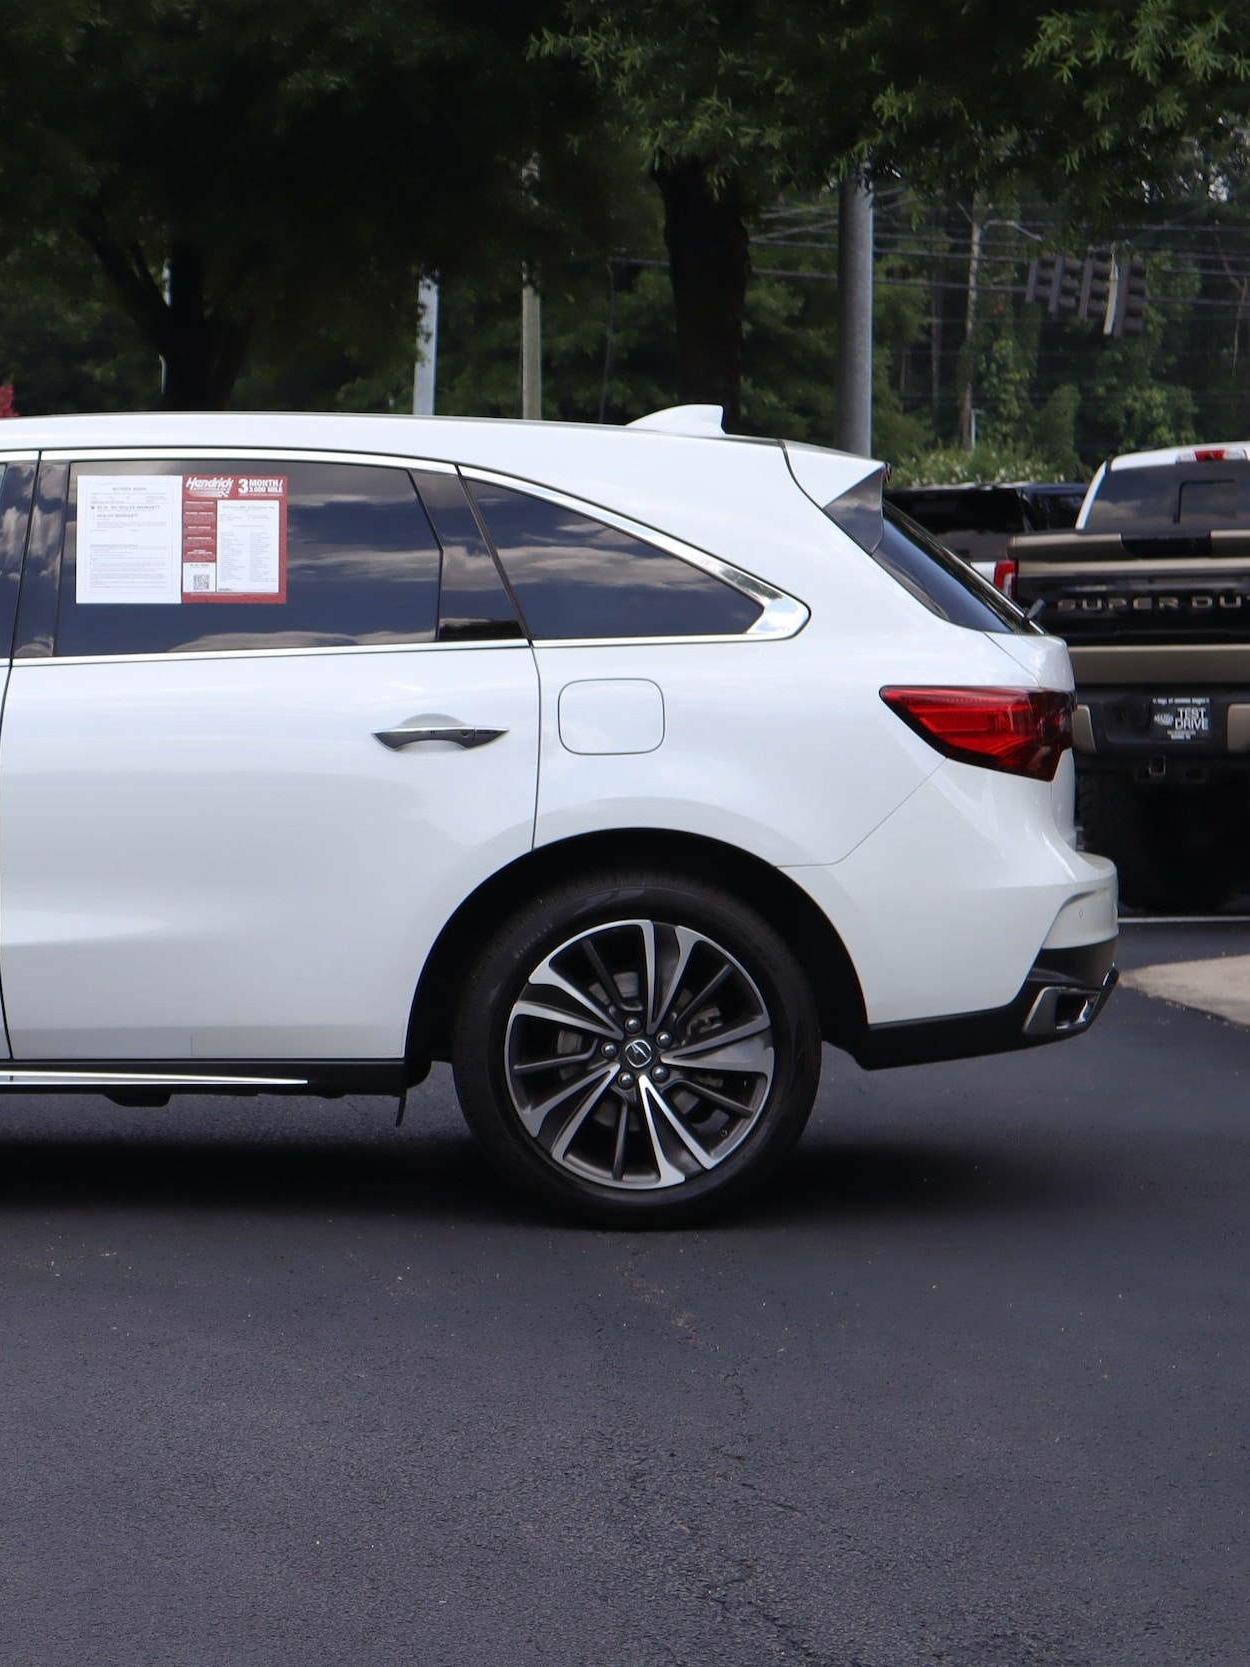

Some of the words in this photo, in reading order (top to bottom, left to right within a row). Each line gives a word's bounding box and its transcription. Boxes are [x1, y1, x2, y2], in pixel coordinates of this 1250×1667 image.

[238, 478, 249, 493] 3
[249, 479, 284, 487] MONTH/
[1057, 597, 1179, 611] SUPER
[1192, 596, 1250, 608] DU
[1177, 707, 1206, 718] TEST
[1174, 717, 1209, 731] DRIVE
